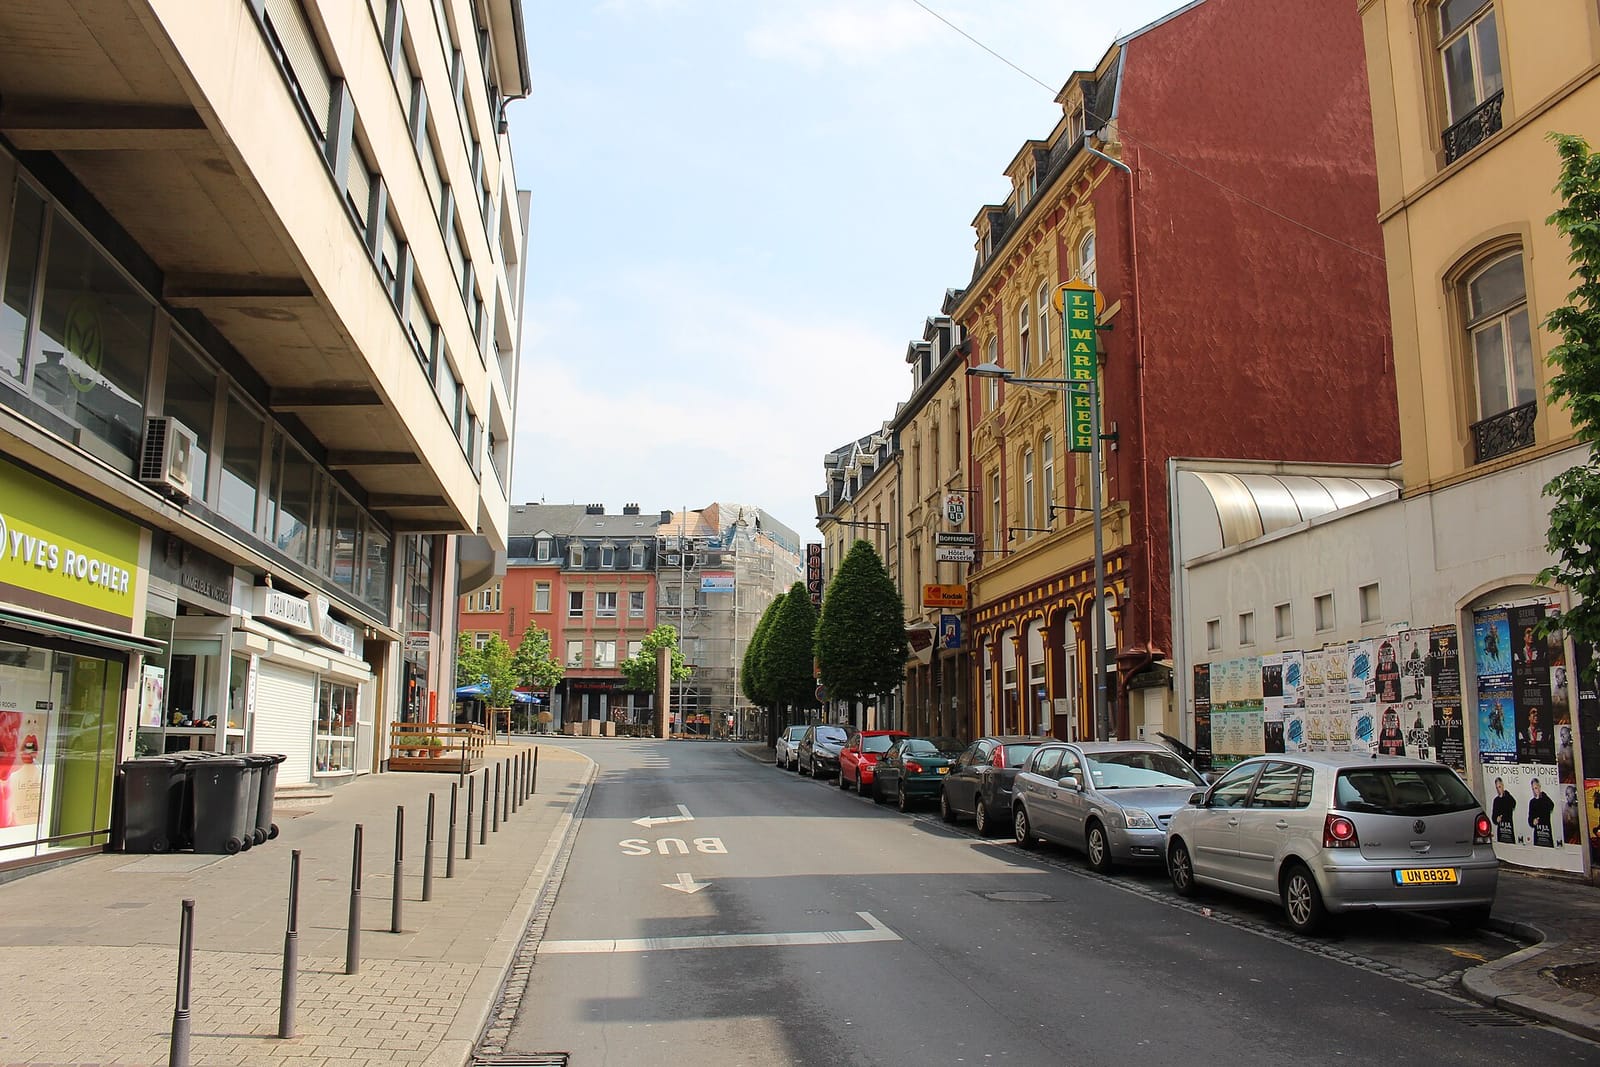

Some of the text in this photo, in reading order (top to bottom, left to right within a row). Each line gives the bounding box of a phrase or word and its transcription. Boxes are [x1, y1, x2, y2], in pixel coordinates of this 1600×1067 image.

[1071, 295, 1089, 320] LE
[1070, 328, 1093, 447] MARRAKECH
[939, 535, 974, 543] BOFFERDING
[9, 529, 129, 594] YVES ROCHER
[1485, 766, 1519, 776] TOM JONES
[1521, 766, 1558, 776] TOM JONES
[1545, 778, 1559, 786] LIVE
[618, 837, 728, 856] BUS
[1407, 869, 1451, 881] UN 8832
